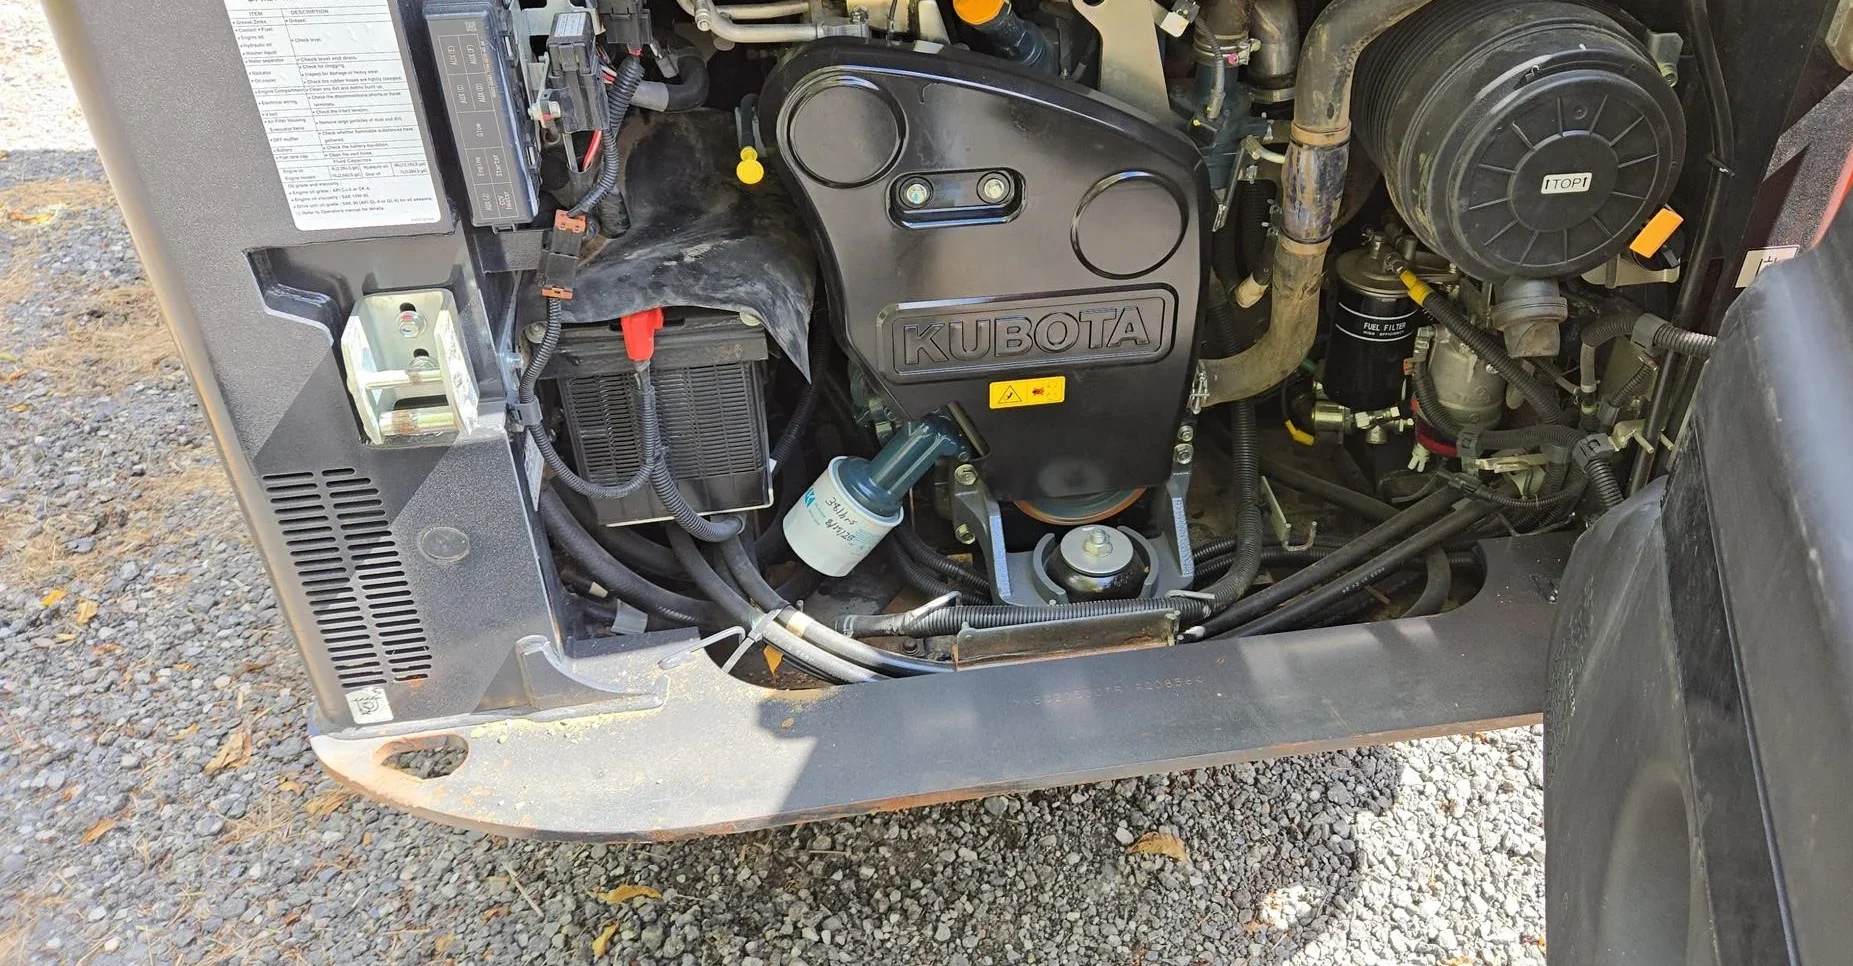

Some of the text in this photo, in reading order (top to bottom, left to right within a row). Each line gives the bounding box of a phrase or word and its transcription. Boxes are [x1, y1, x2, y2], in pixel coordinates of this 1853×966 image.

[1553, 177, 1581, 189] TOP
[1363, 321, 1406, 331] FUEL FILTER
[903, 306, 1150, 365] KUBOTA
